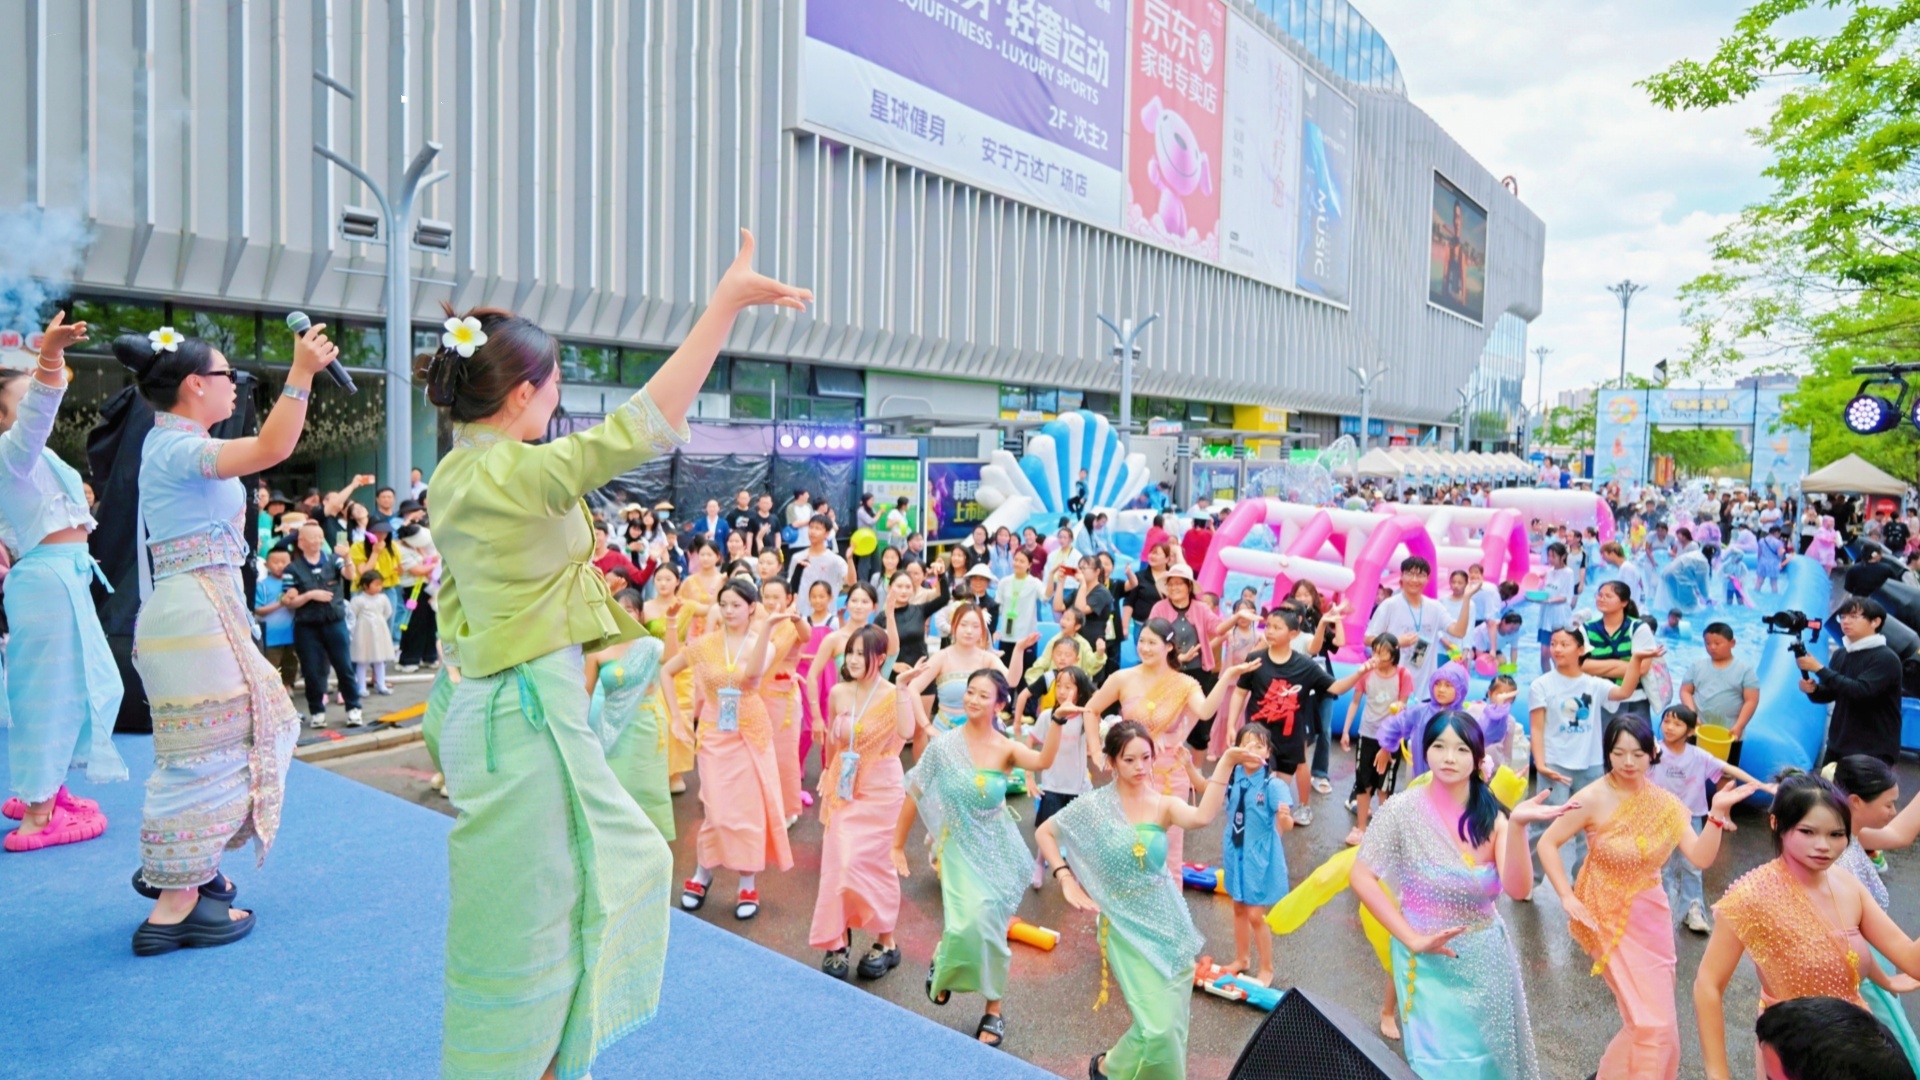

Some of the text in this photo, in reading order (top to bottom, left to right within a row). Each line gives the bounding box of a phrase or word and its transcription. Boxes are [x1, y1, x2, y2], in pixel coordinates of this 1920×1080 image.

[1142, 0, 1196, 66] 京东
[1001, 40, 1055, 81] LUXURY
[1056, 69, 1099, 105] SPORTS
[1141, 41, 1217, 114] 家电专卖店
[870, 88, 945, 146] 星球健身
[982, 137, 1088, 198] 安宁万达广场店
[1314, 188, 1328, 277] MUSIC
